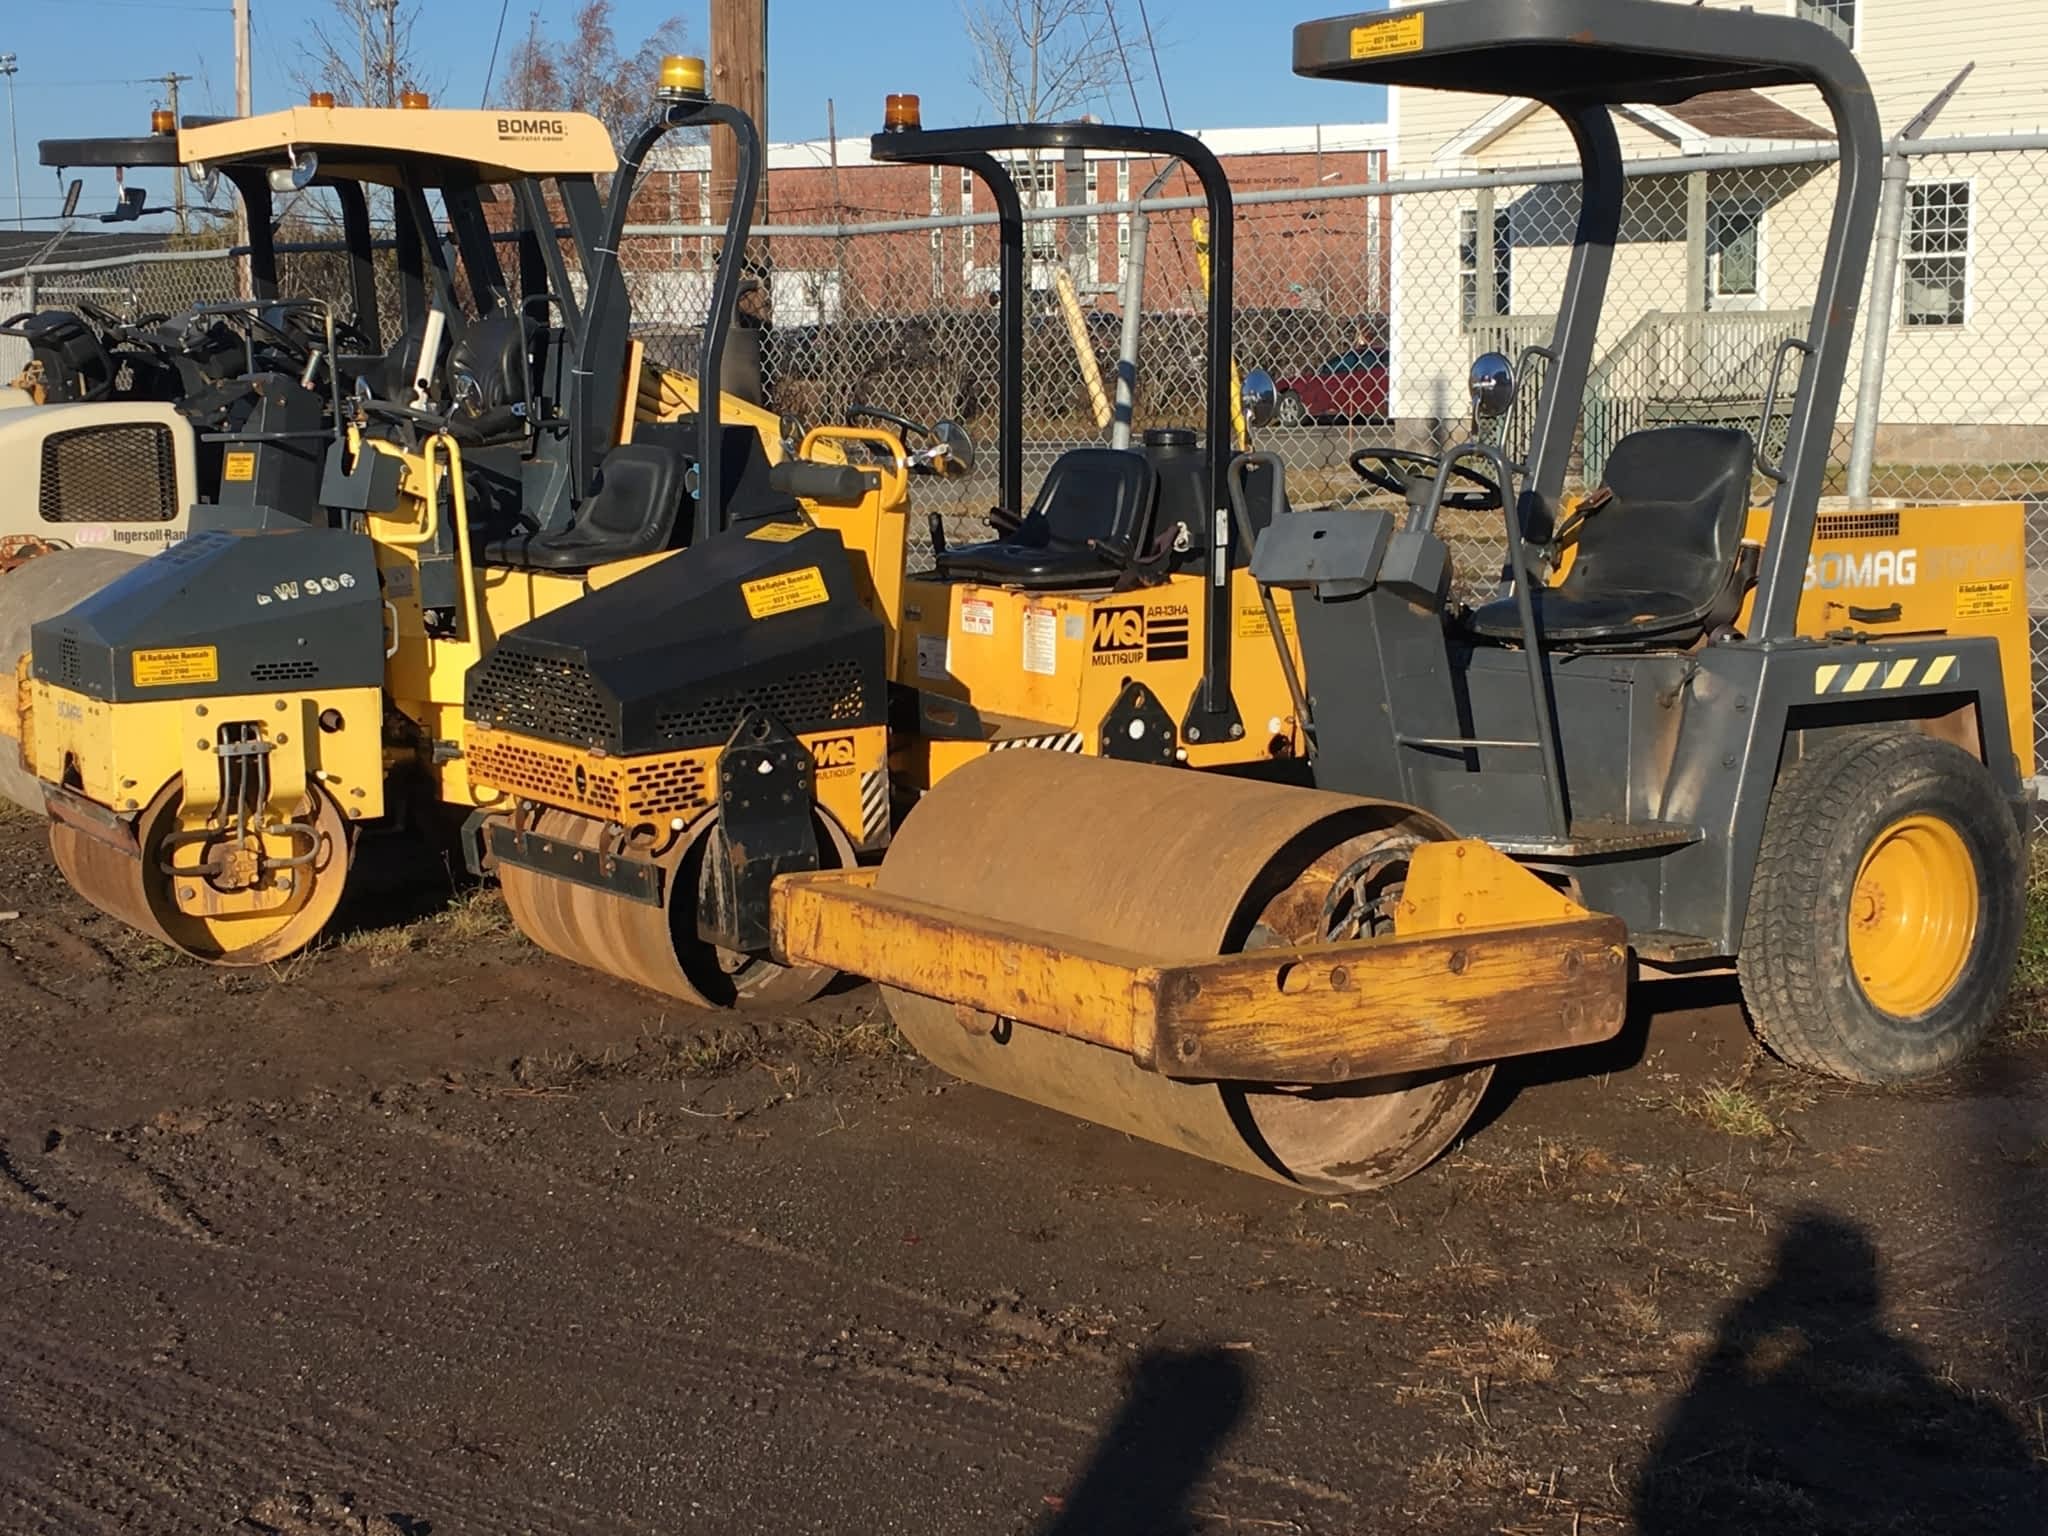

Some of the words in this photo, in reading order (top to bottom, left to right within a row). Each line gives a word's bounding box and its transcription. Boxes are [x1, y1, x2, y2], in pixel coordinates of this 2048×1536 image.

[497, 119, 563, 134] BOMAG
[113, 529, 162, 544] Ingersoll
[164, 529, 186, 540] Ran
[1092, 608, 1143, 651] MQ
[1092, 652, 1144, 667] MULTIQUIP
[812, 738, 855, 768] MQ
[816, 768, 857, 780] ULTIQUIP
